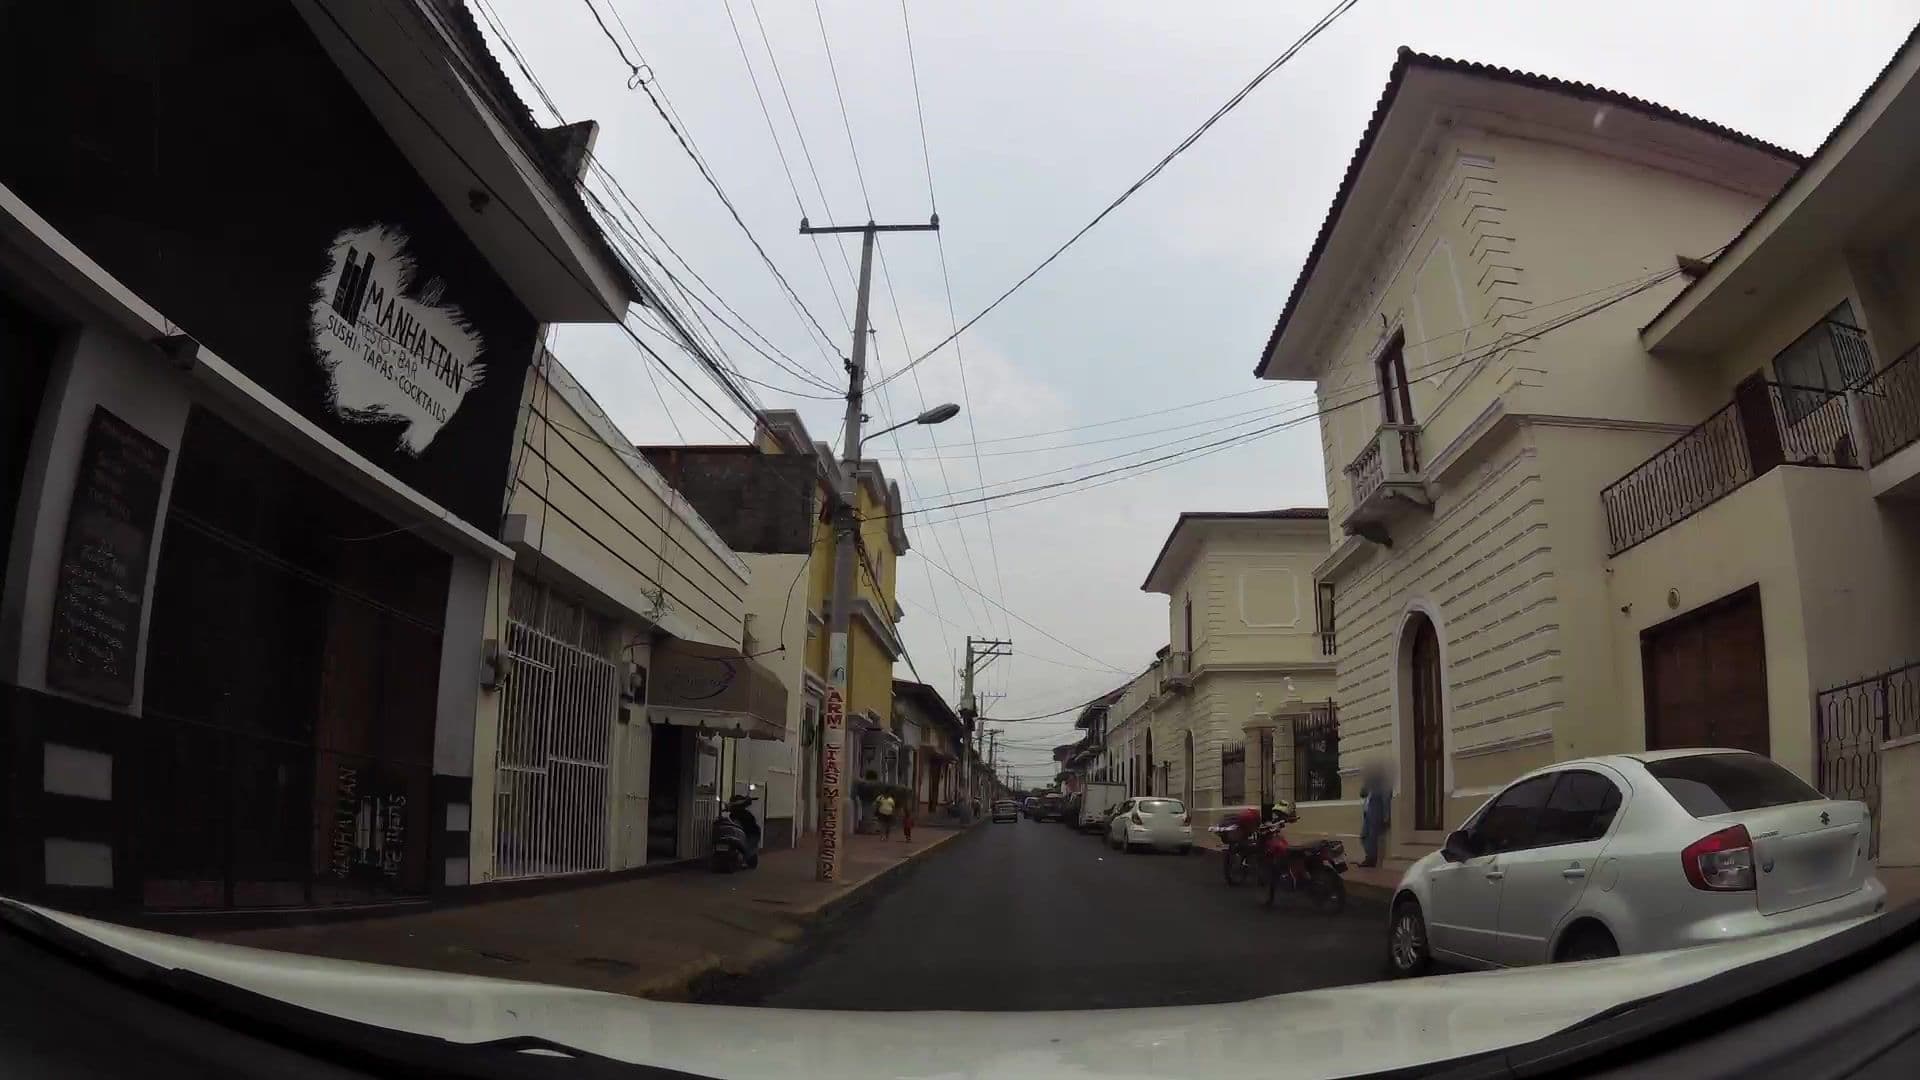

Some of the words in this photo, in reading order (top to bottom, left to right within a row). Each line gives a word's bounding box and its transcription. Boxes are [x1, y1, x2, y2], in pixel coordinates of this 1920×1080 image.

[327, 314, 357, 351] SUSHI
[362, 345, 393, 381] TAPAS
[399, 375, 448, 423] COCKTAILS
[360, 316, 391, 355] RESTO
[398, 352, 418, 381] BAR
[362, 280, 464, 393] MANHATTAN
